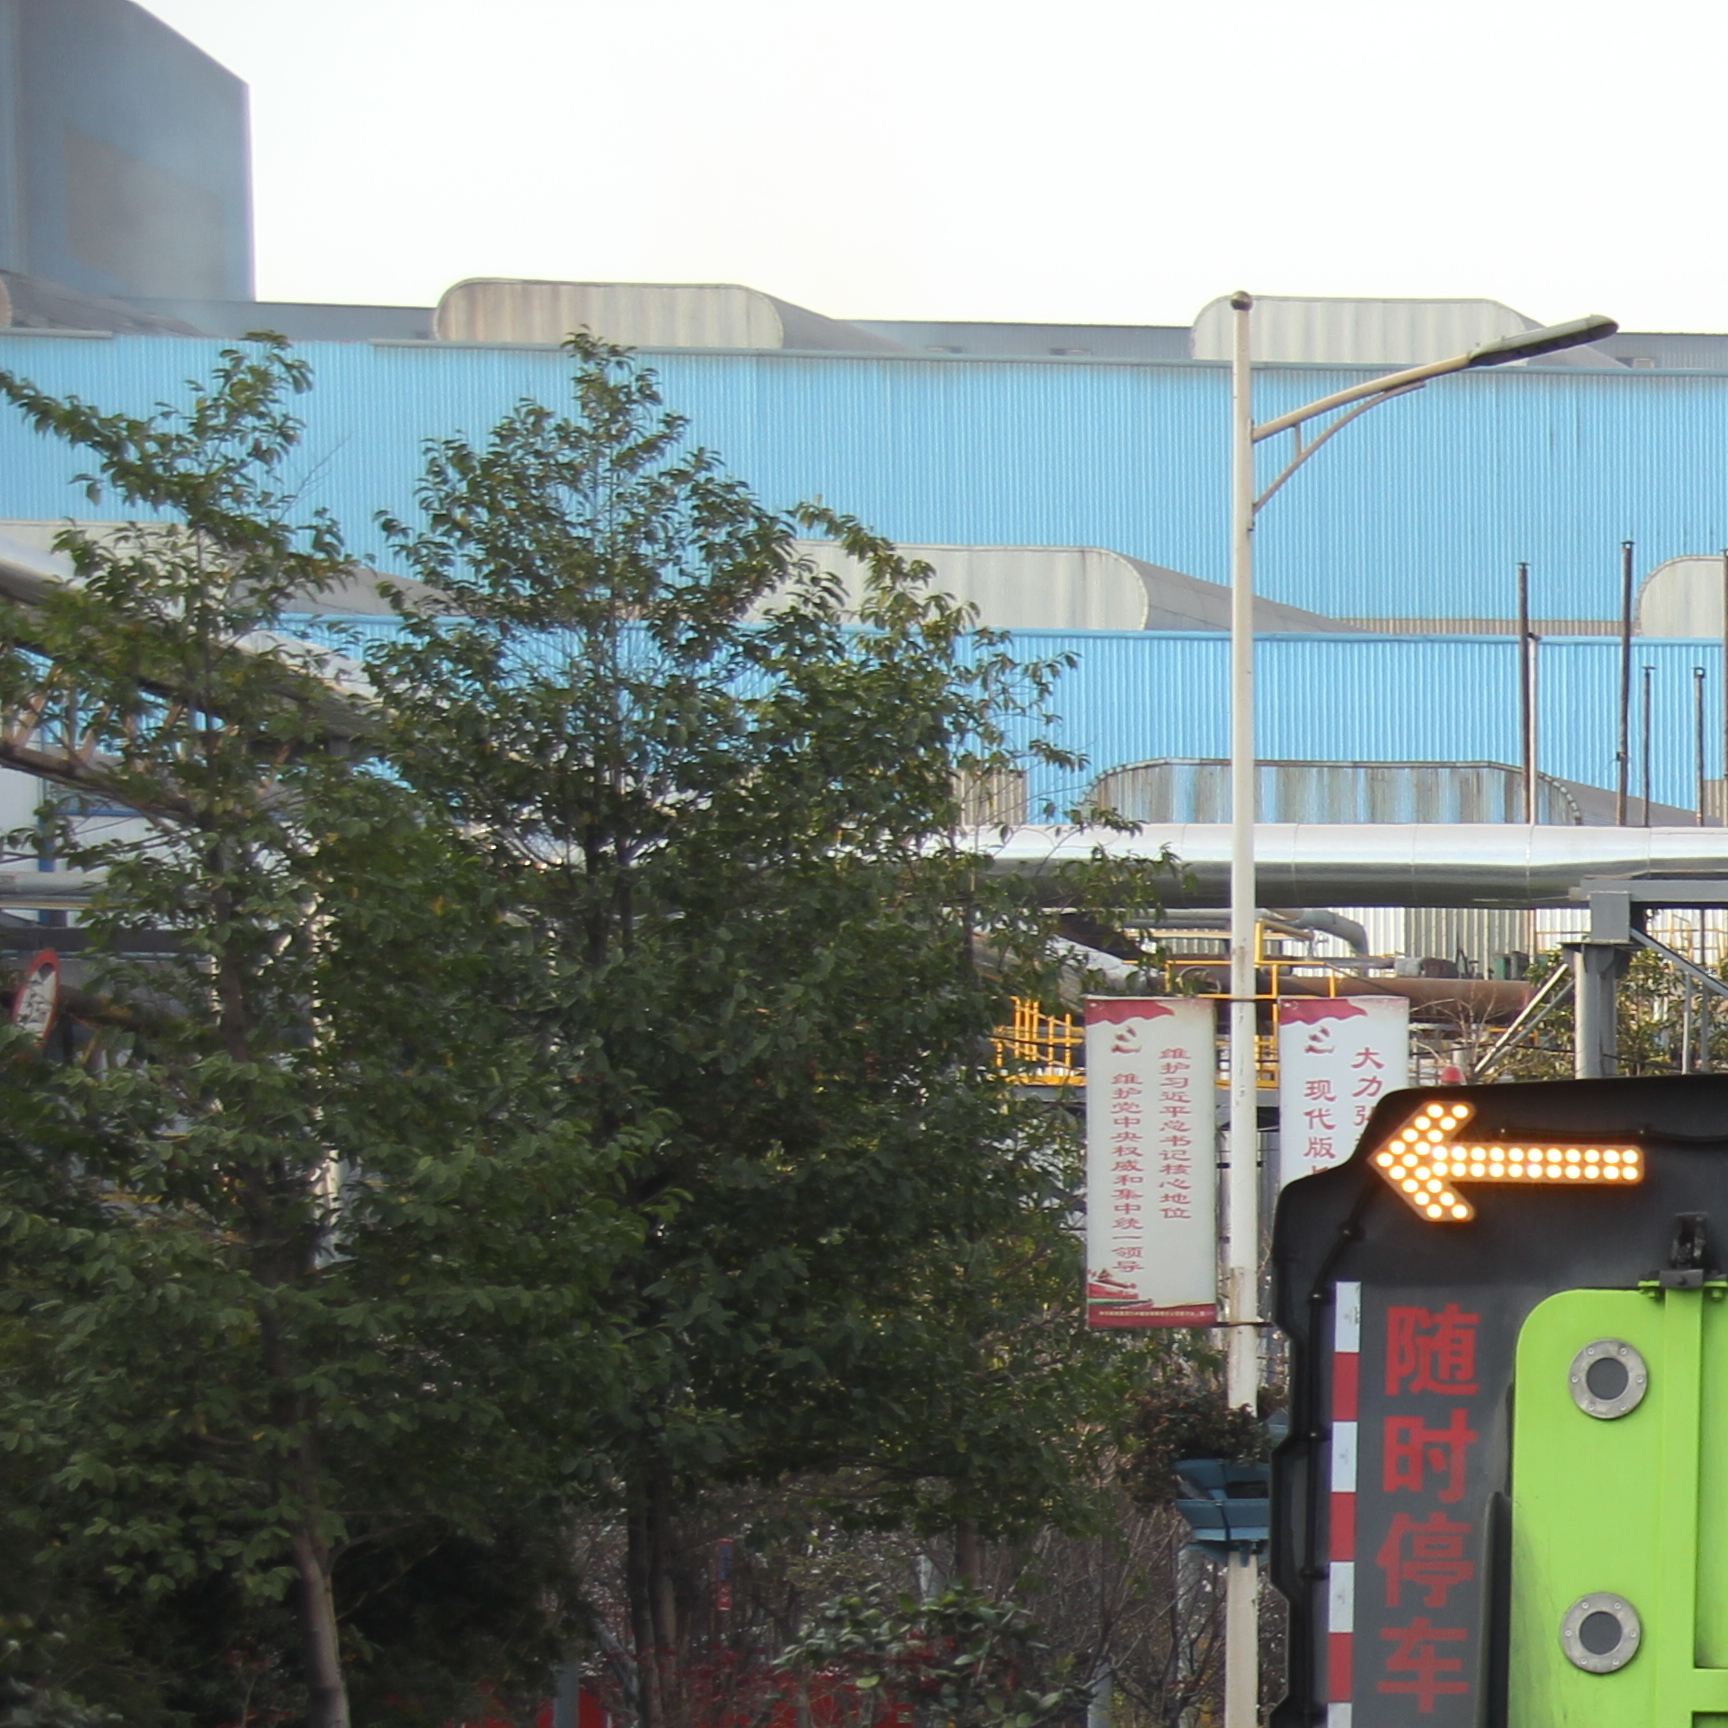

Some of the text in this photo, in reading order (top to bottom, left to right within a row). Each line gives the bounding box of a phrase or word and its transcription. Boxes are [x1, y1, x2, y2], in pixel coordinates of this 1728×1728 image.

[1109, 1073, 1145, 1274] 维护党中央权威和集中统一领导
[1158, 1047, 1193, 1220] 维护习近平总书记核心地位
[1376, 1302, 1481, 1713] 随时停车
